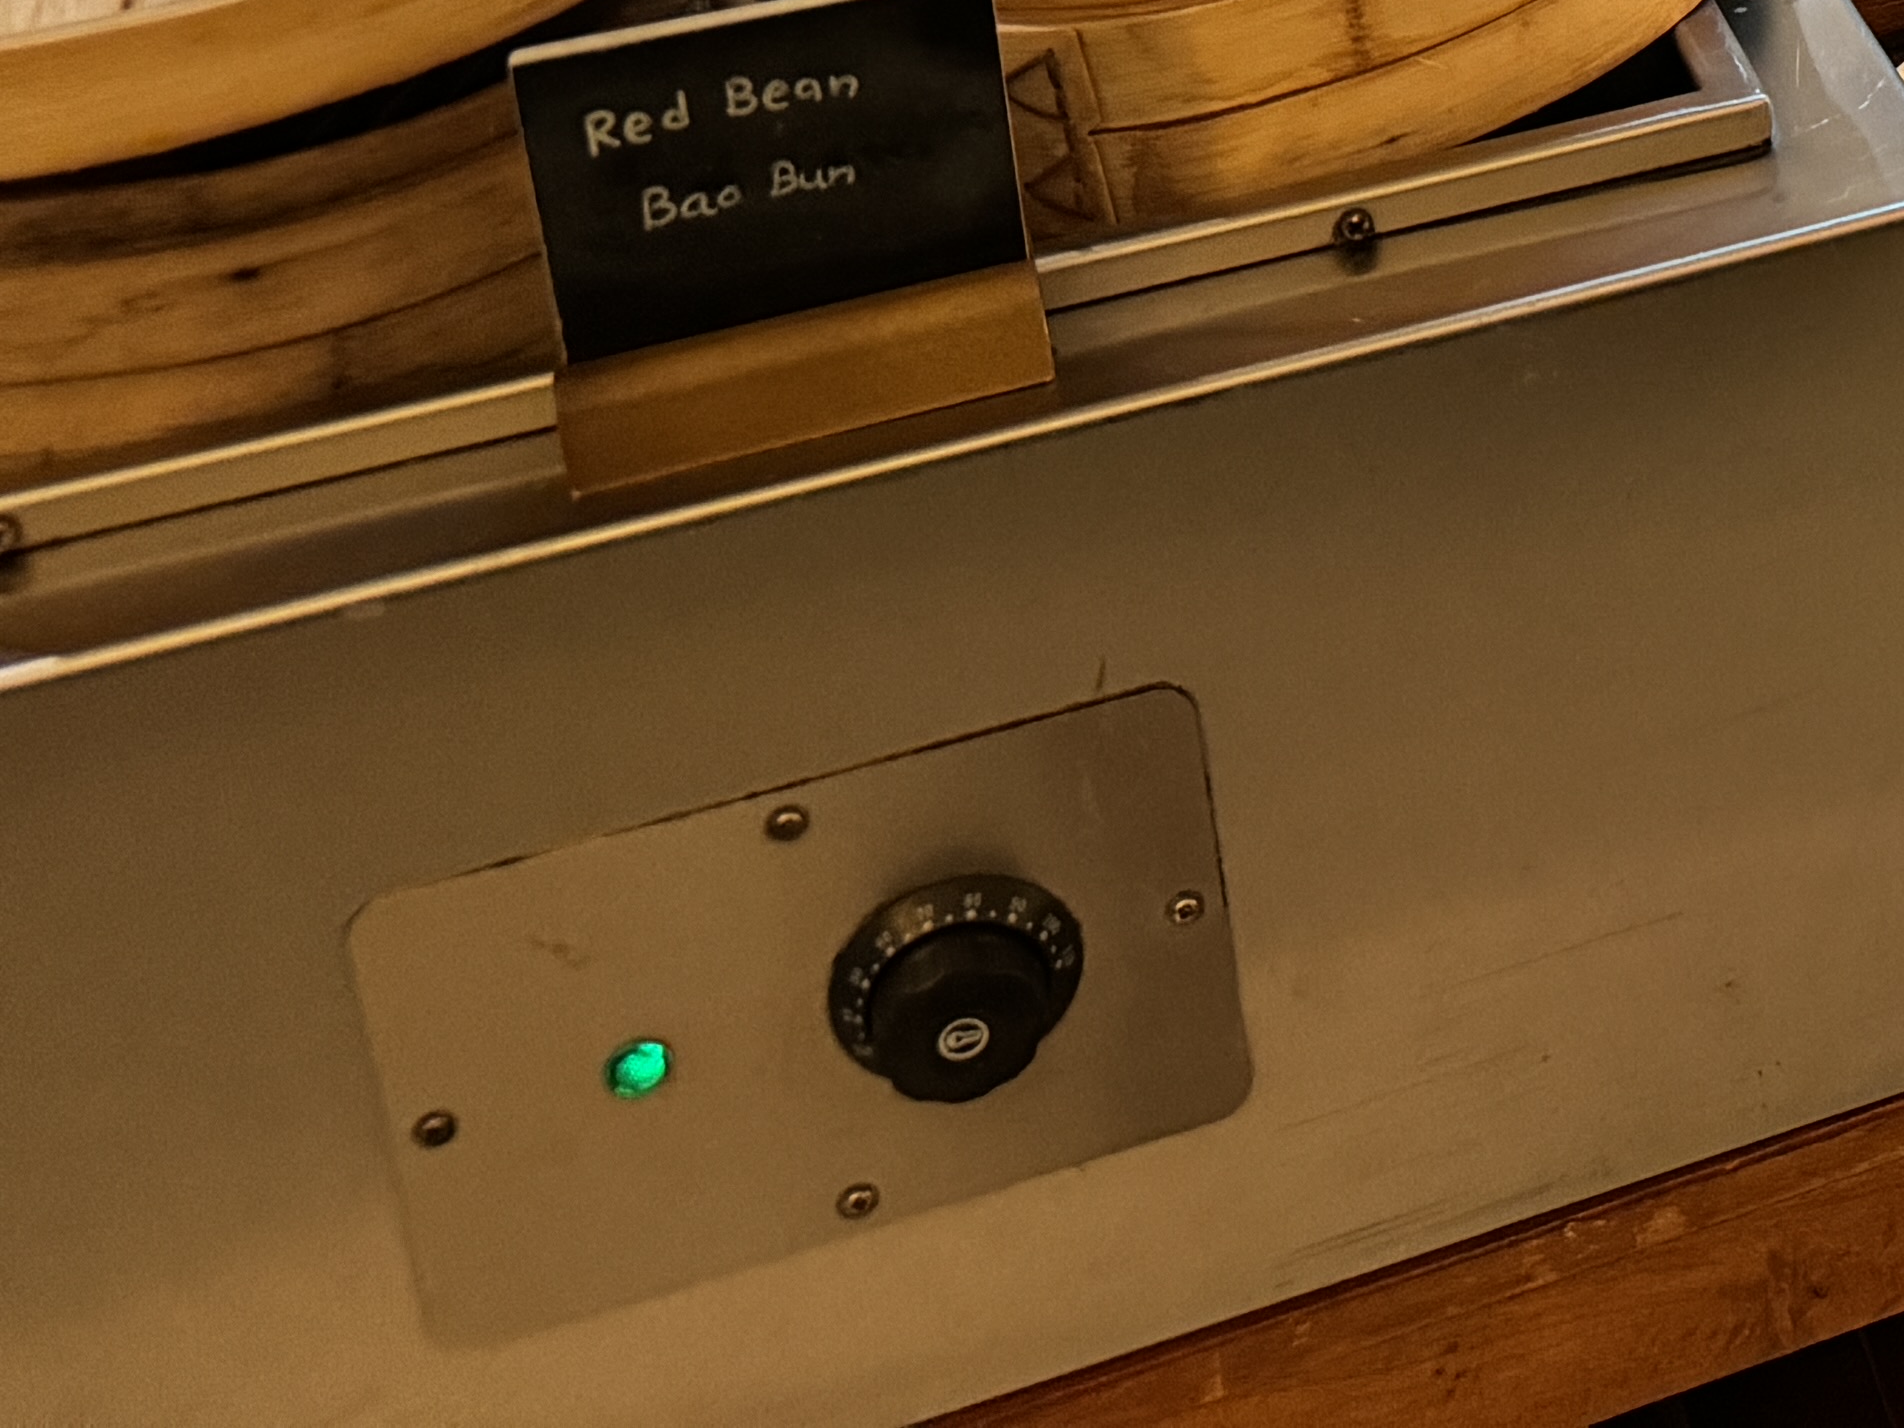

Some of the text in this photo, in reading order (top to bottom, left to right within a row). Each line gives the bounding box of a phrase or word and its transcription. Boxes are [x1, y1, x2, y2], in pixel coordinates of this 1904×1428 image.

[584, 73, 860, 158] Red Bean
[640, 158, 857, 231] Bao Bun
